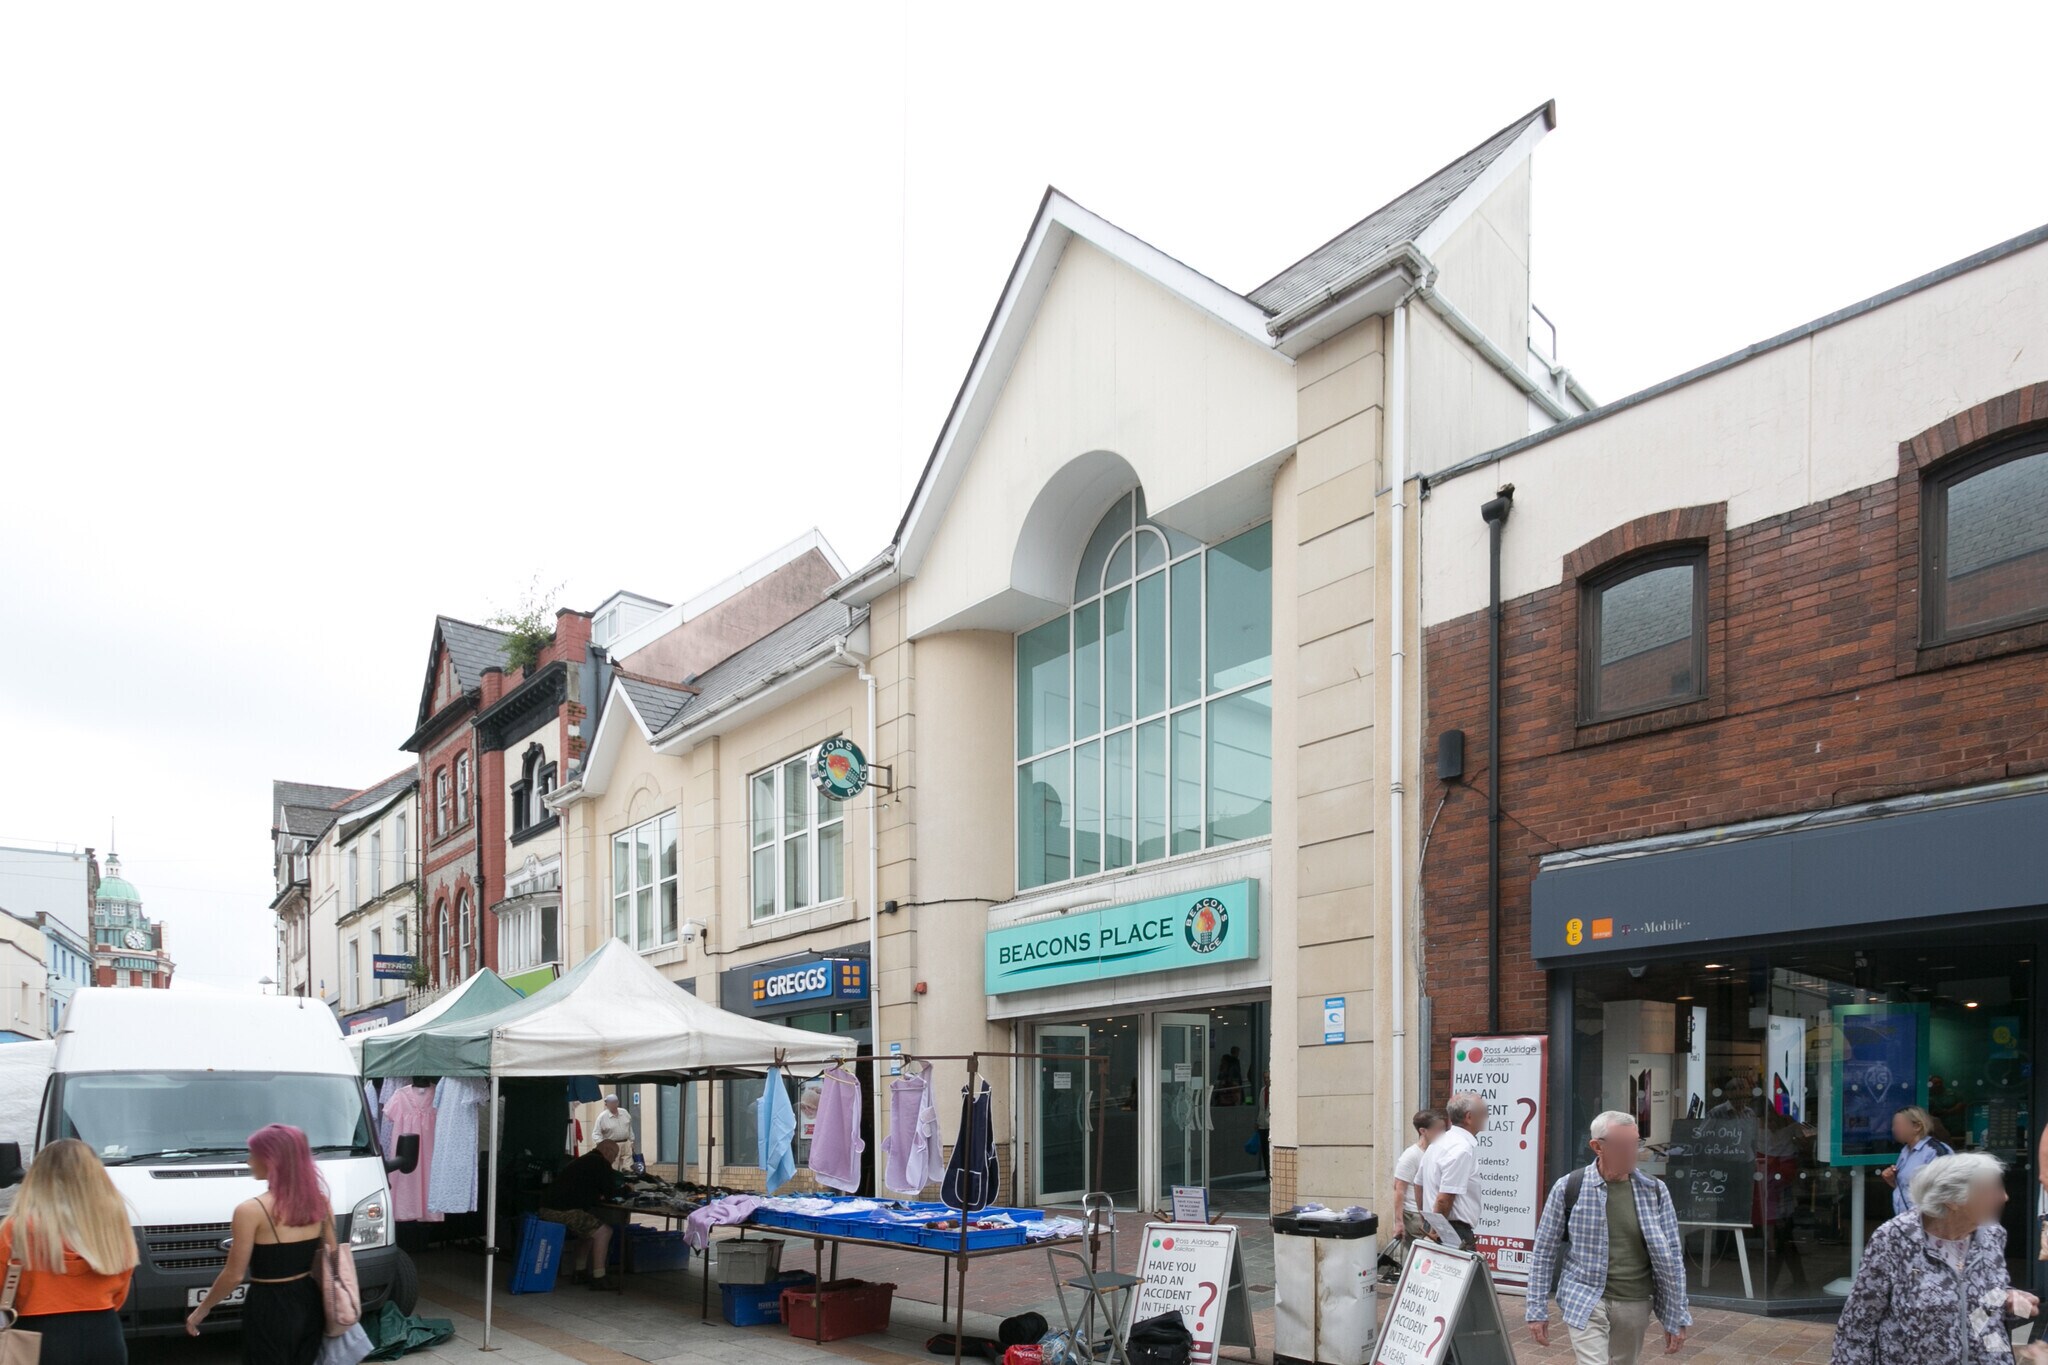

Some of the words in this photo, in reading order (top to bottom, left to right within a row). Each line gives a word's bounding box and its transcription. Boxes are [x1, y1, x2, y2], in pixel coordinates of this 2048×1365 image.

[819, 740, 852, 788] BEACONS
[847, 764, 866, 796] PLACE
[1185, 898, 1228, 927] BEACONS
[999, 932, 1090, 965] BEACONS
[1100, 917, 1174, 948] PLACE
[1191, 937, 1221, 953] PLACE
[766, 967, 827, 997] GREGGS
[1484, 1046, 1500, 1054] Ross
[1504, 1045, 1537, 1055] Aldridge
[1455, 1073, 1483, 1084] HAVE
[1486, 1072, 1510, 1084] YOU
[1481, 1089, 1497, 1099] AN
[1488, 1120, 1515, 1132] LAST
[1718, 1127, 1742, 1145] Only
[1478, 1157, 1510, 1166] cidents?
[1481, 1188, 1518, 1197] ccidents?
[1483, 1203, 1531, 1214] Negligence?
[1175, 1237, 1189, 1246] Ross
[1191, 1238, 1220, 1247] Aldridge
[1490, 1236, 1505, 1247] No
[1506, 1238, 1524, 1249] Fee
[1148, 1260, 1174, 1272] HAVE
[1176, 1262, 1196, 1273] YOU
[1146, 1274, 1168, 1285] HAD
[1169, 1276, 1184, 1286] AN
[1143, 1288, 1192, 1301] ACCIDENT
[1405, 1281, 1423, 1298] HAVE
[1425, 1288, 1440, 1303] YOU
[1141, 1301, 1152, 1311] IN
[1153, 1302, 1170, 1313] THE
[1400, 1297, 1416, 1313] HAD
[1415, 1303, 1428, 1317] AN
[1394, 1314, 1428, 1335] ACCIDENT
[1389, 1328, 1397, 1341] IN
[1396, 1332, 1408, 1347] THE
[1408, 1336, 1426, 1354] LAST
[1382, 1345, 1388, 1356] 3
[1388, 1347, 1408, 1365] YEARS
